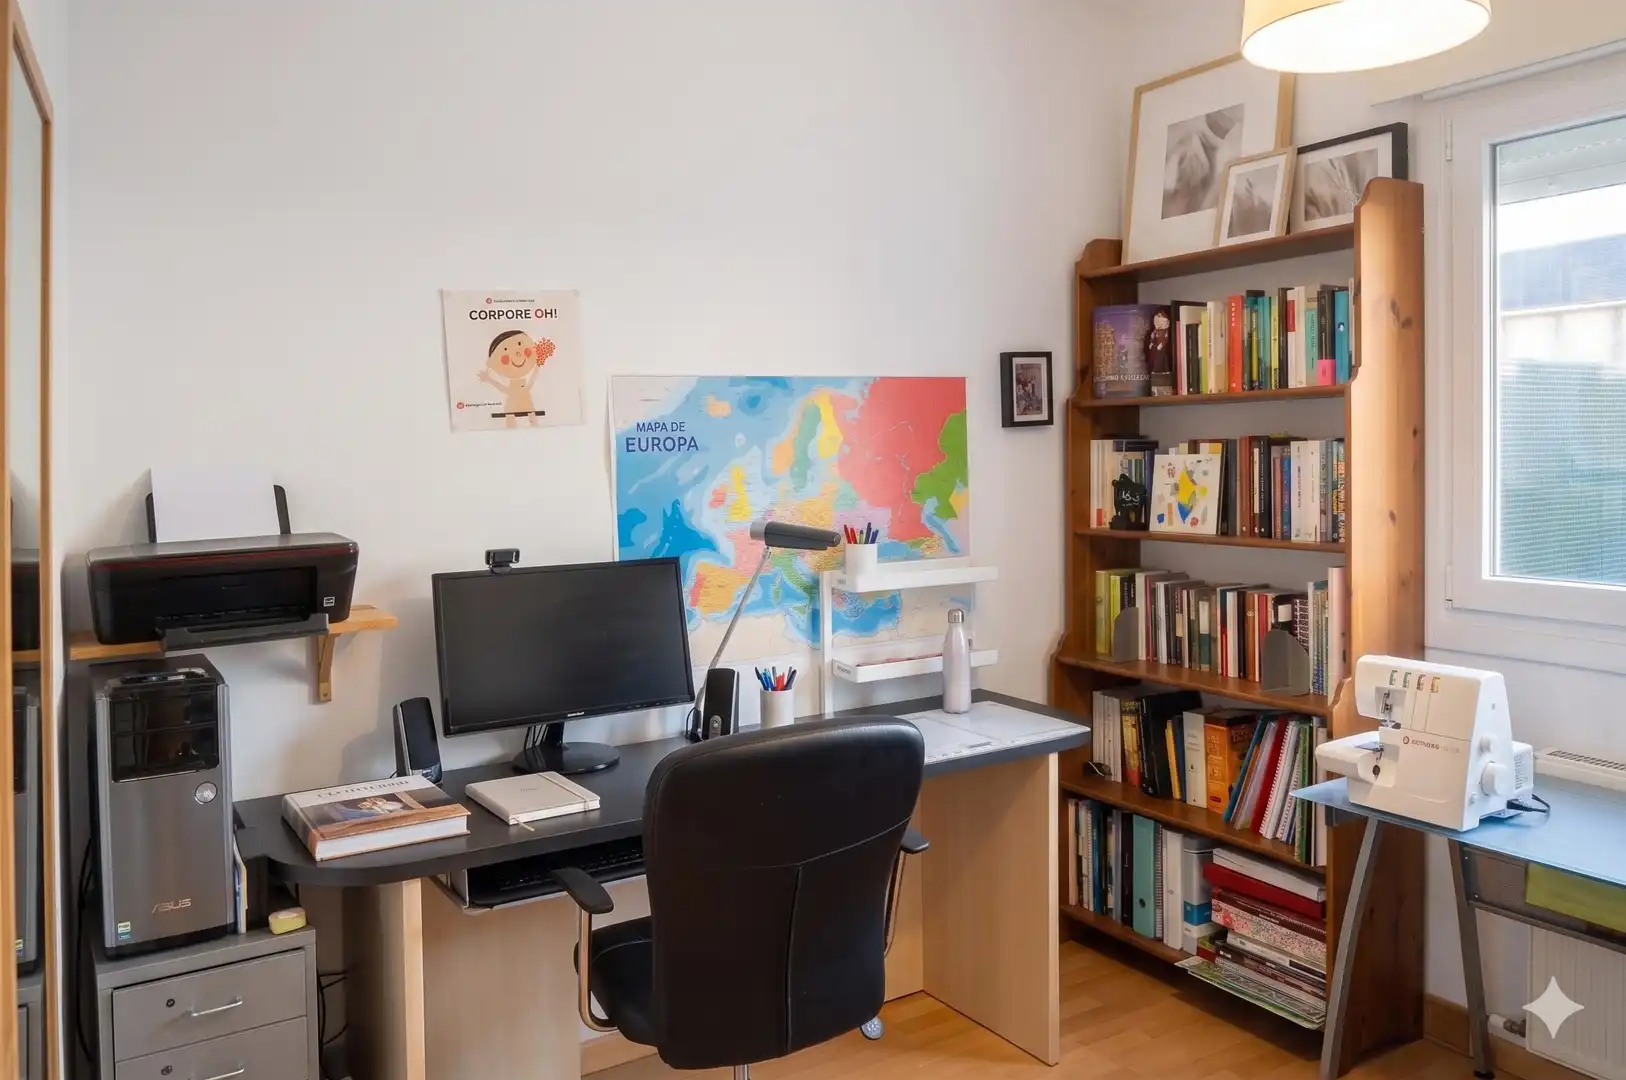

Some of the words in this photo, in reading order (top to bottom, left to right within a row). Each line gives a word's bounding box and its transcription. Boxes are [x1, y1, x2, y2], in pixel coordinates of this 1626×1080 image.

[469, 309, 532, 321] CORPORE
[534, 308, 558, 319] OH!
[636, 422, 668, 433] MAPA
[670, 422, 686, 432] DE
[625, 436, 699, 453] EUROPA
[151, 898, 192, 913] ASUS
